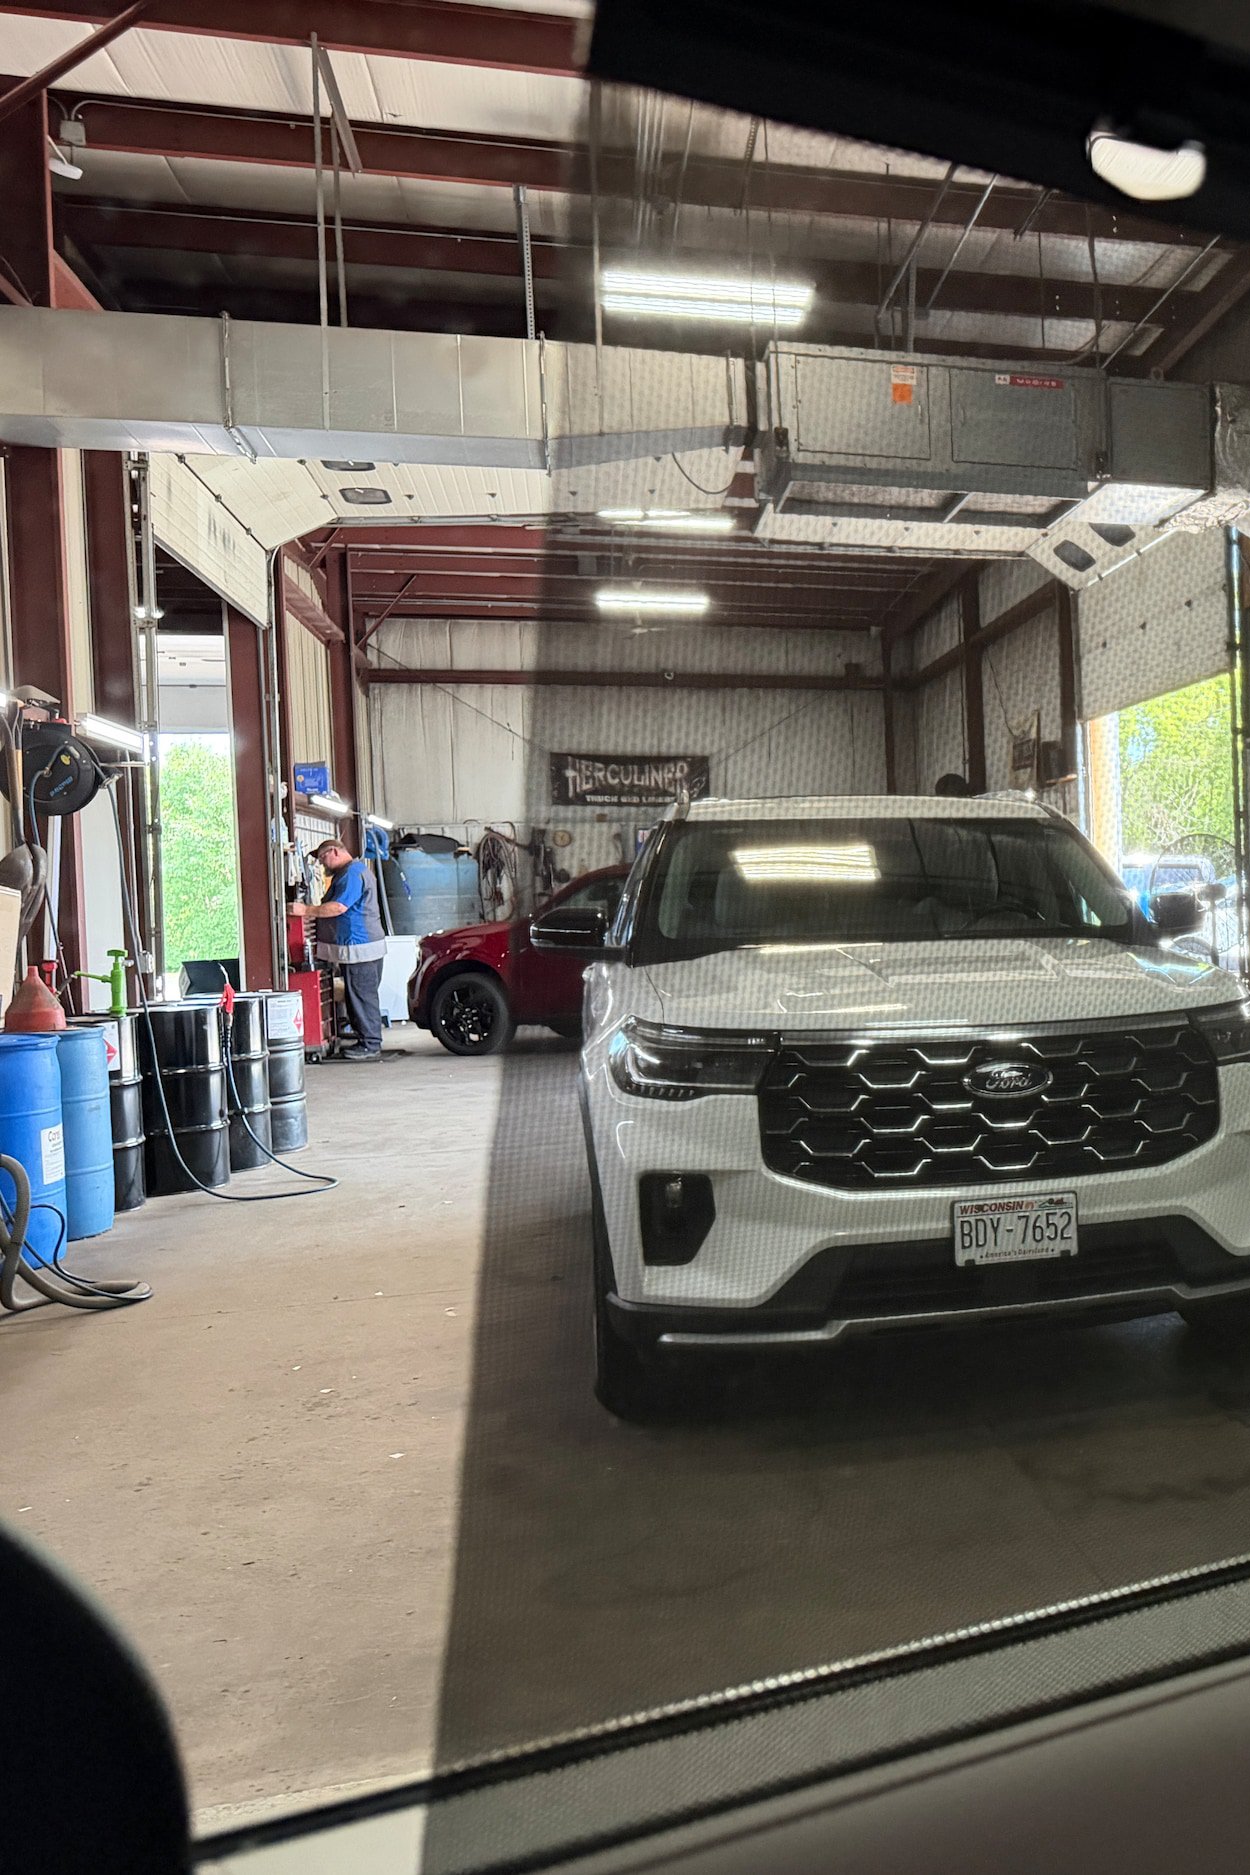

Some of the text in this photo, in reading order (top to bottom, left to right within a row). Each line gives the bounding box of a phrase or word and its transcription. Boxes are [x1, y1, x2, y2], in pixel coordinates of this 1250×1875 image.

[565, 755, 689, 800] HERCULINER
[960, 1200, 1024, 1215] WISCONSIN
[960, 1211, 1072, 1249] BDY-7652
